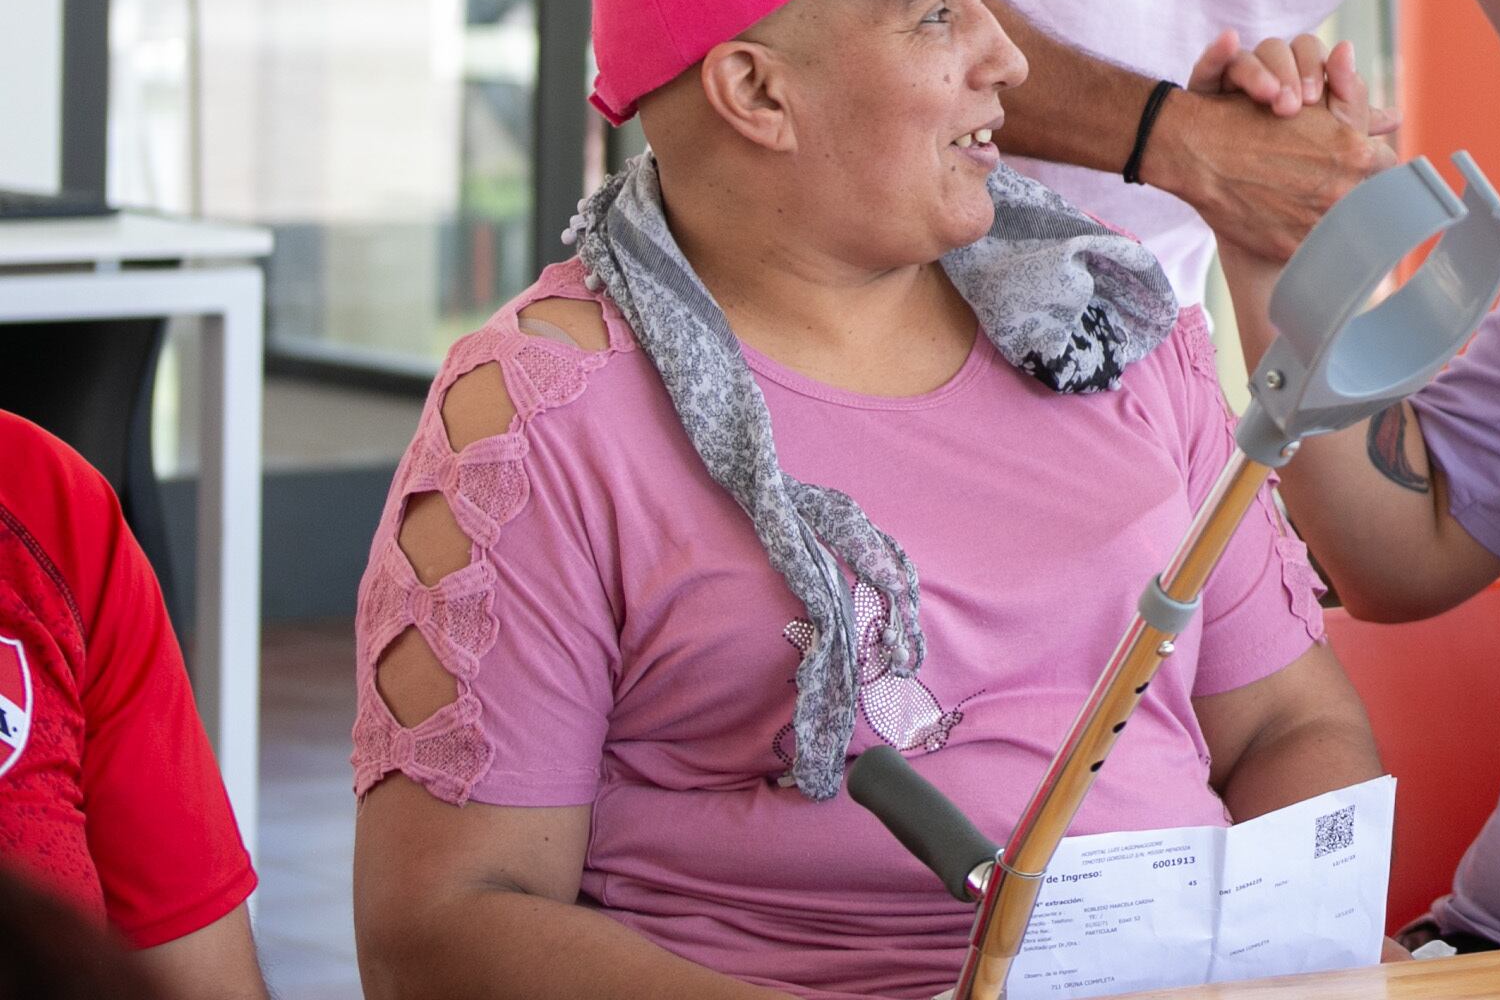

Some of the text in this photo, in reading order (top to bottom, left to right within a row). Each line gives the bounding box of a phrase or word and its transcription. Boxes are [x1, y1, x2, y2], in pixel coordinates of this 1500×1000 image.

[1152, 856, 1196, 869] 6001913
[1046, 870, 1103, 884] de Ingreso:
